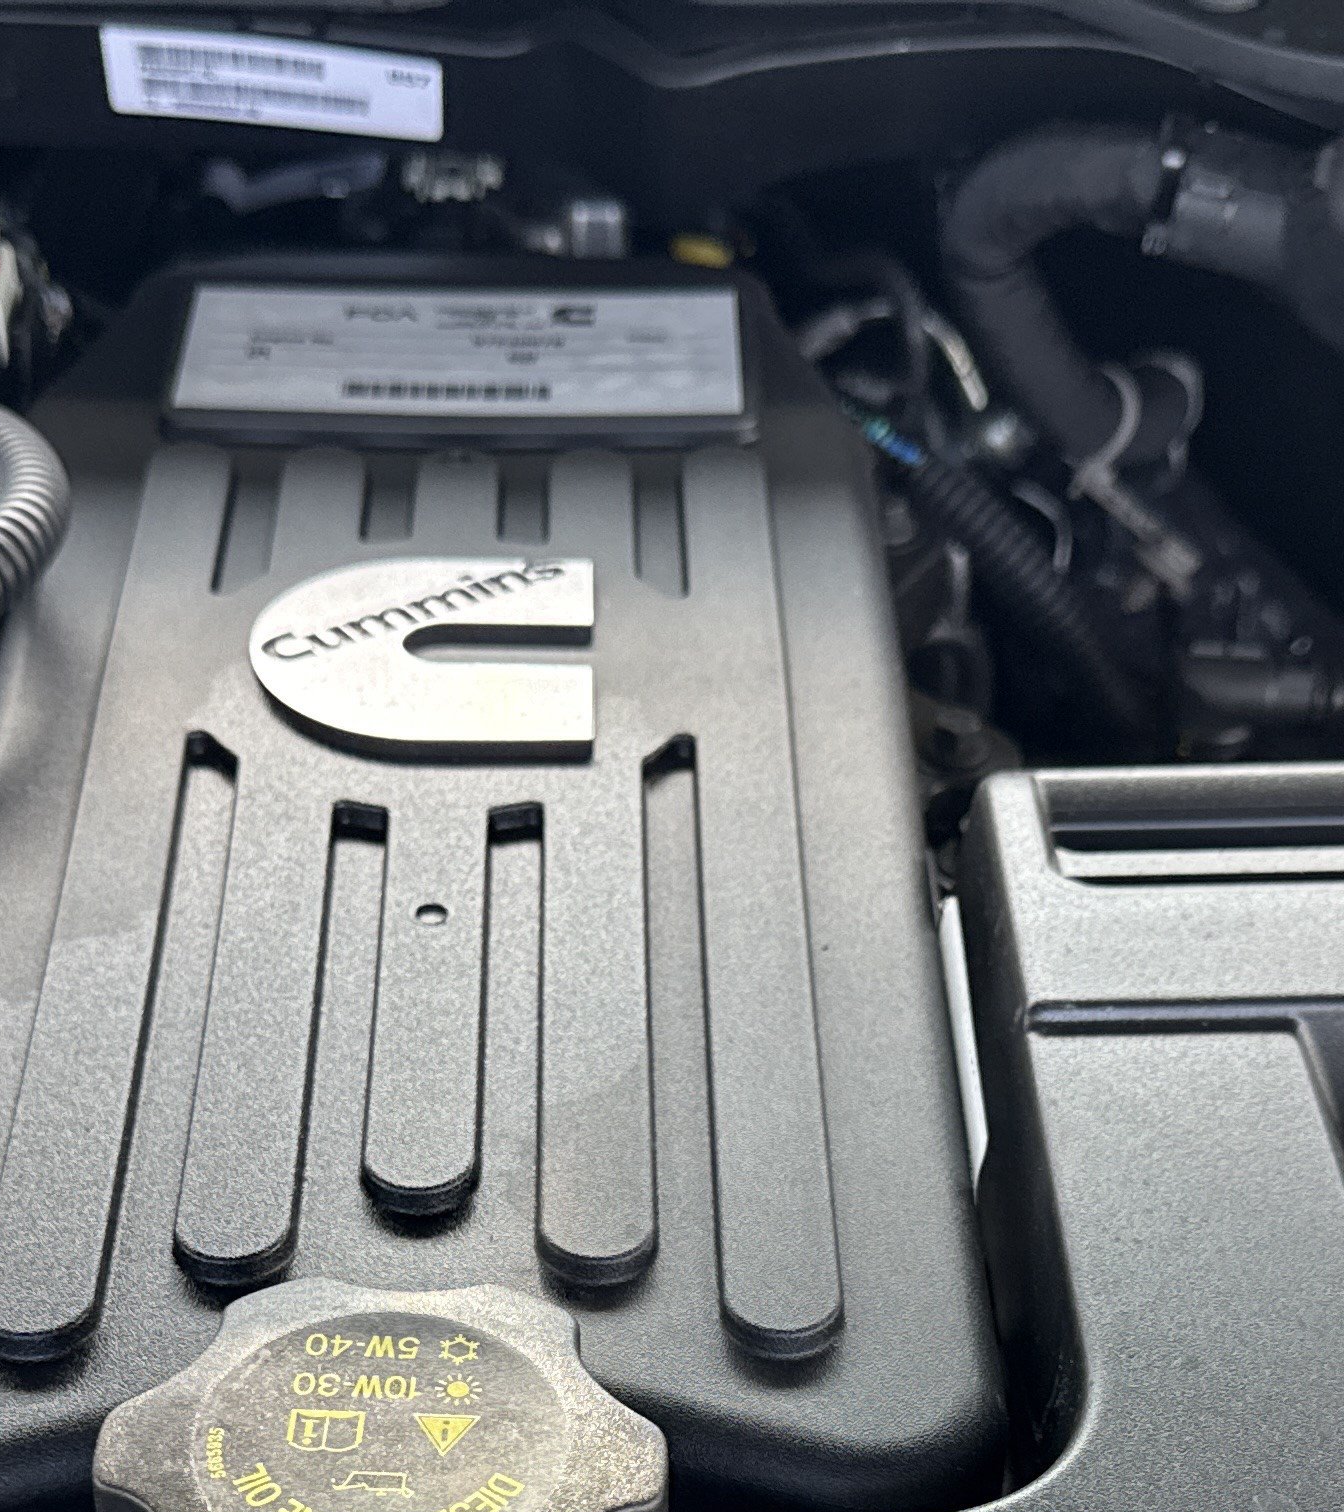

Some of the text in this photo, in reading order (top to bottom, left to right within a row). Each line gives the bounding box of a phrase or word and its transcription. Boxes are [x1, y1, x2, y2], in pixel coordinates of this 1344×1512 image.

[260, 566, 565, 660] Cummins
[305, 1332, 421, 1360] 5W-40
[292, 1371, 423, 1398] 10W-30
[231, 1461, 283, 1508] OIL
